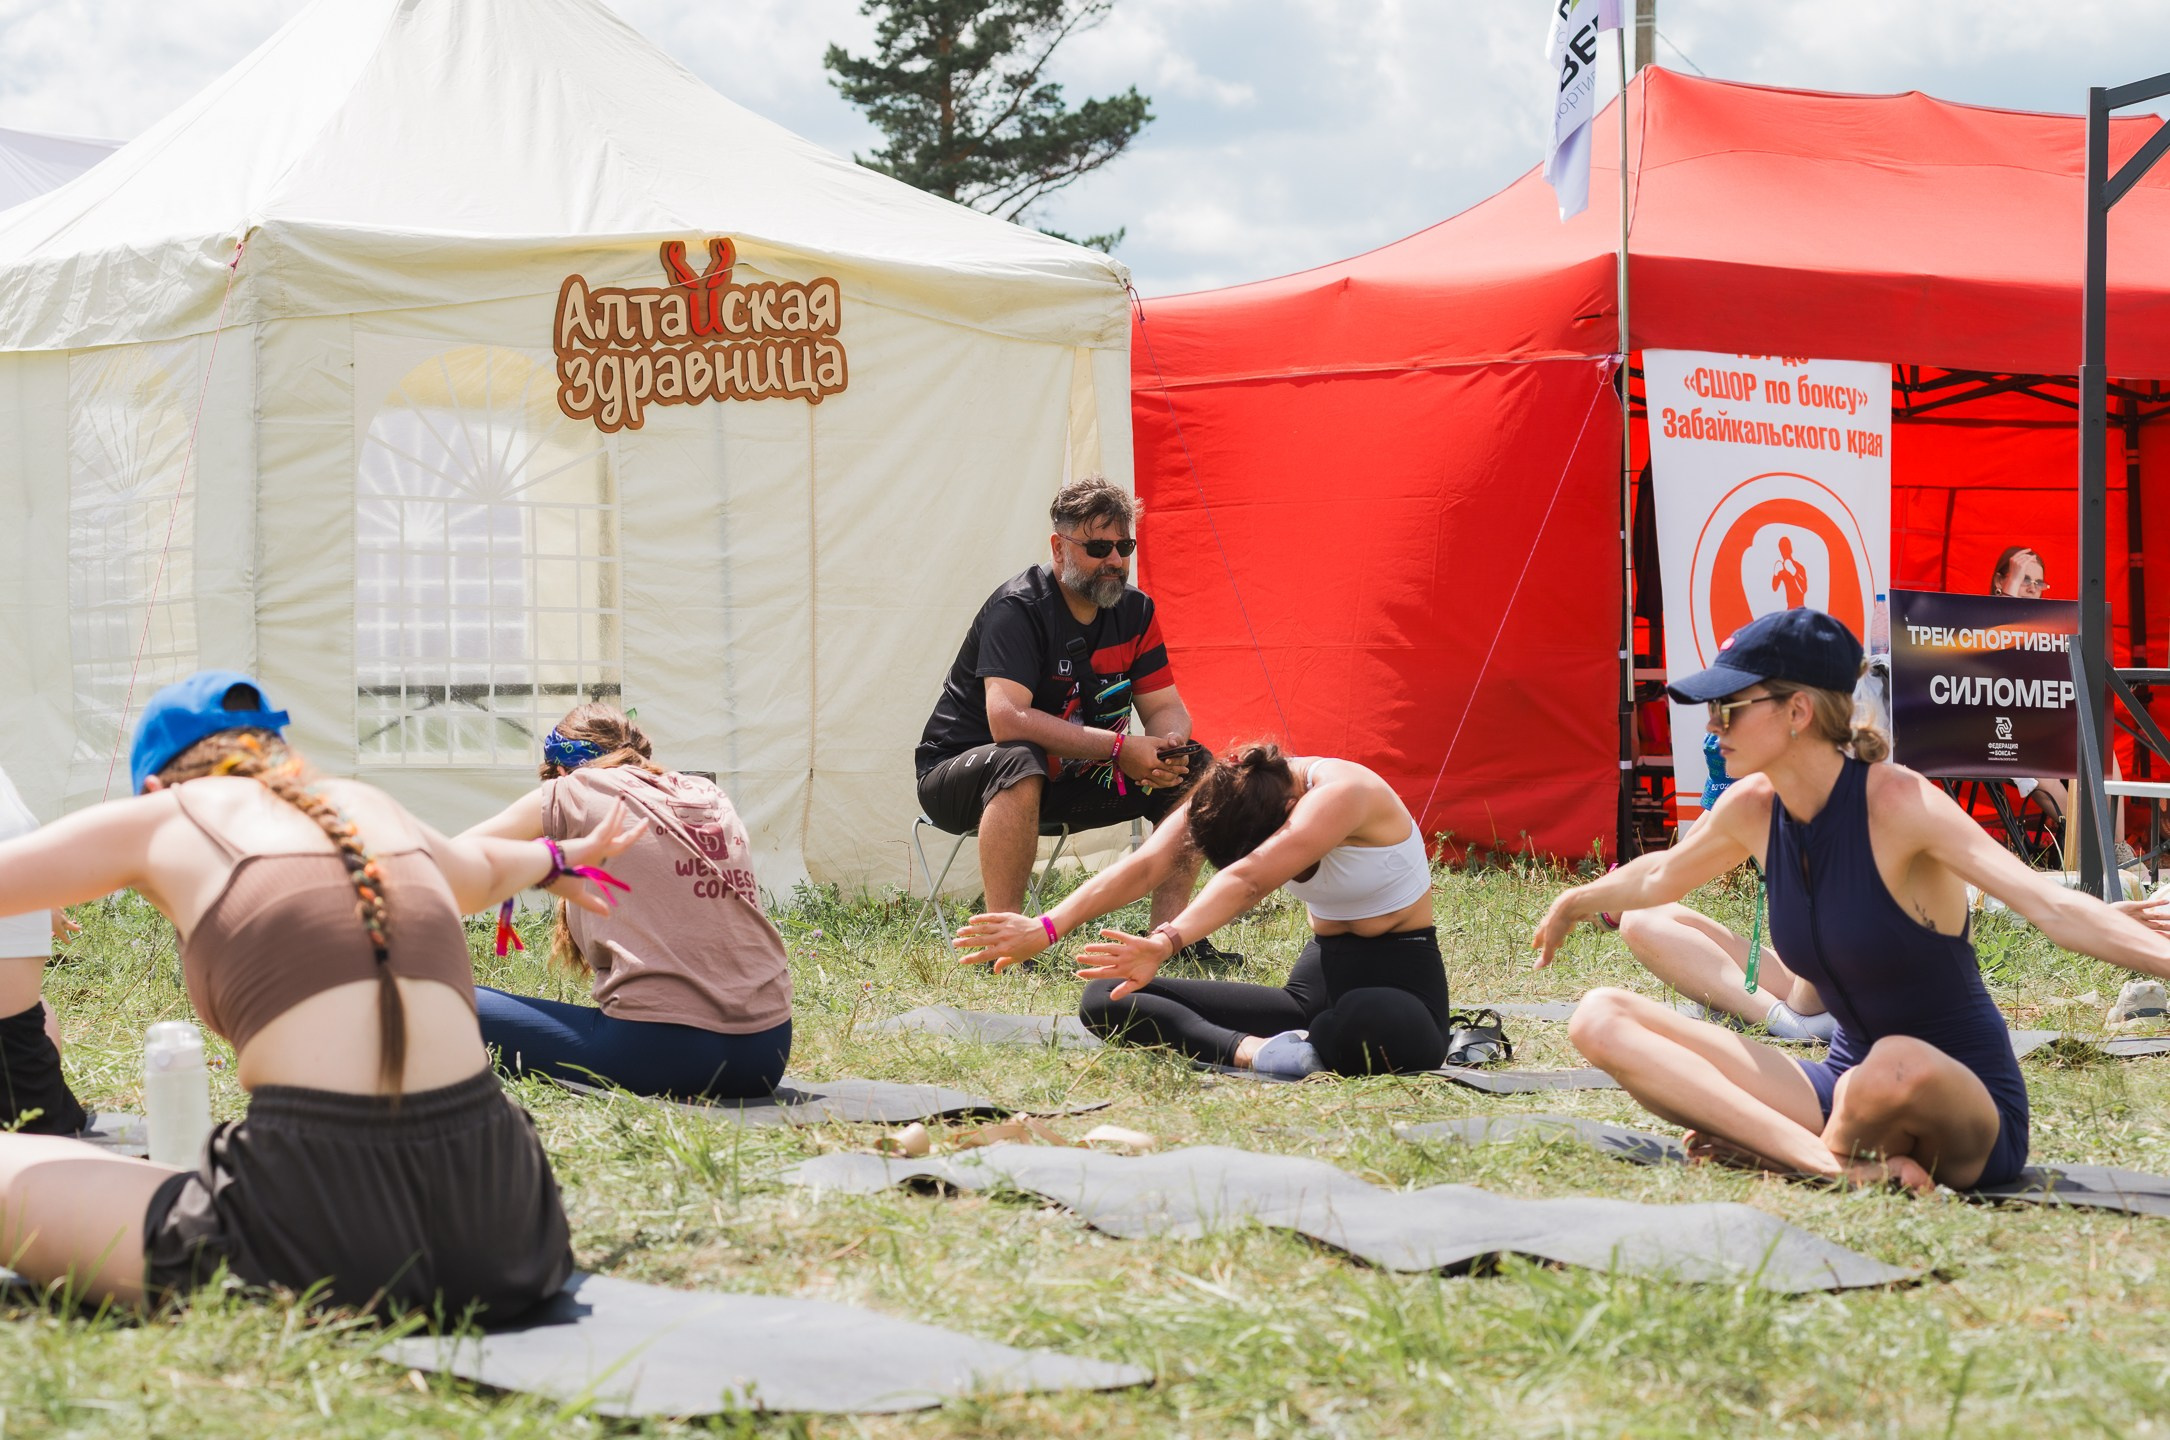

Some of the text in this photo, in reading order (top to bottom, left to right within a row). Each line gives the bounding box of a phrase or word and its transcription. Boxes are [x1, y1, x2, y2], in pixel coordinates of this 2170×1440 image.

[1561, 14, 1599, 93] ВЕ
[1556, 70, 1596, 120] орти
[561, 240, 836, 349] Алтайская
[564, 341, 843, 425] здравница
[1684, 367, 1868, 416] «СШОР по боксу»
[1662, 407, 1883, 459] Забайкальского края
[1907, 624, 2069, 653] ТРЕК СПОРТИВН
[1929, 674, 2076, 709] СИЛОМЕР
[1987, 742, 2019, 750] ФЕДЕРАЦИЯ
[675, 857, 757, 891] WENESS
